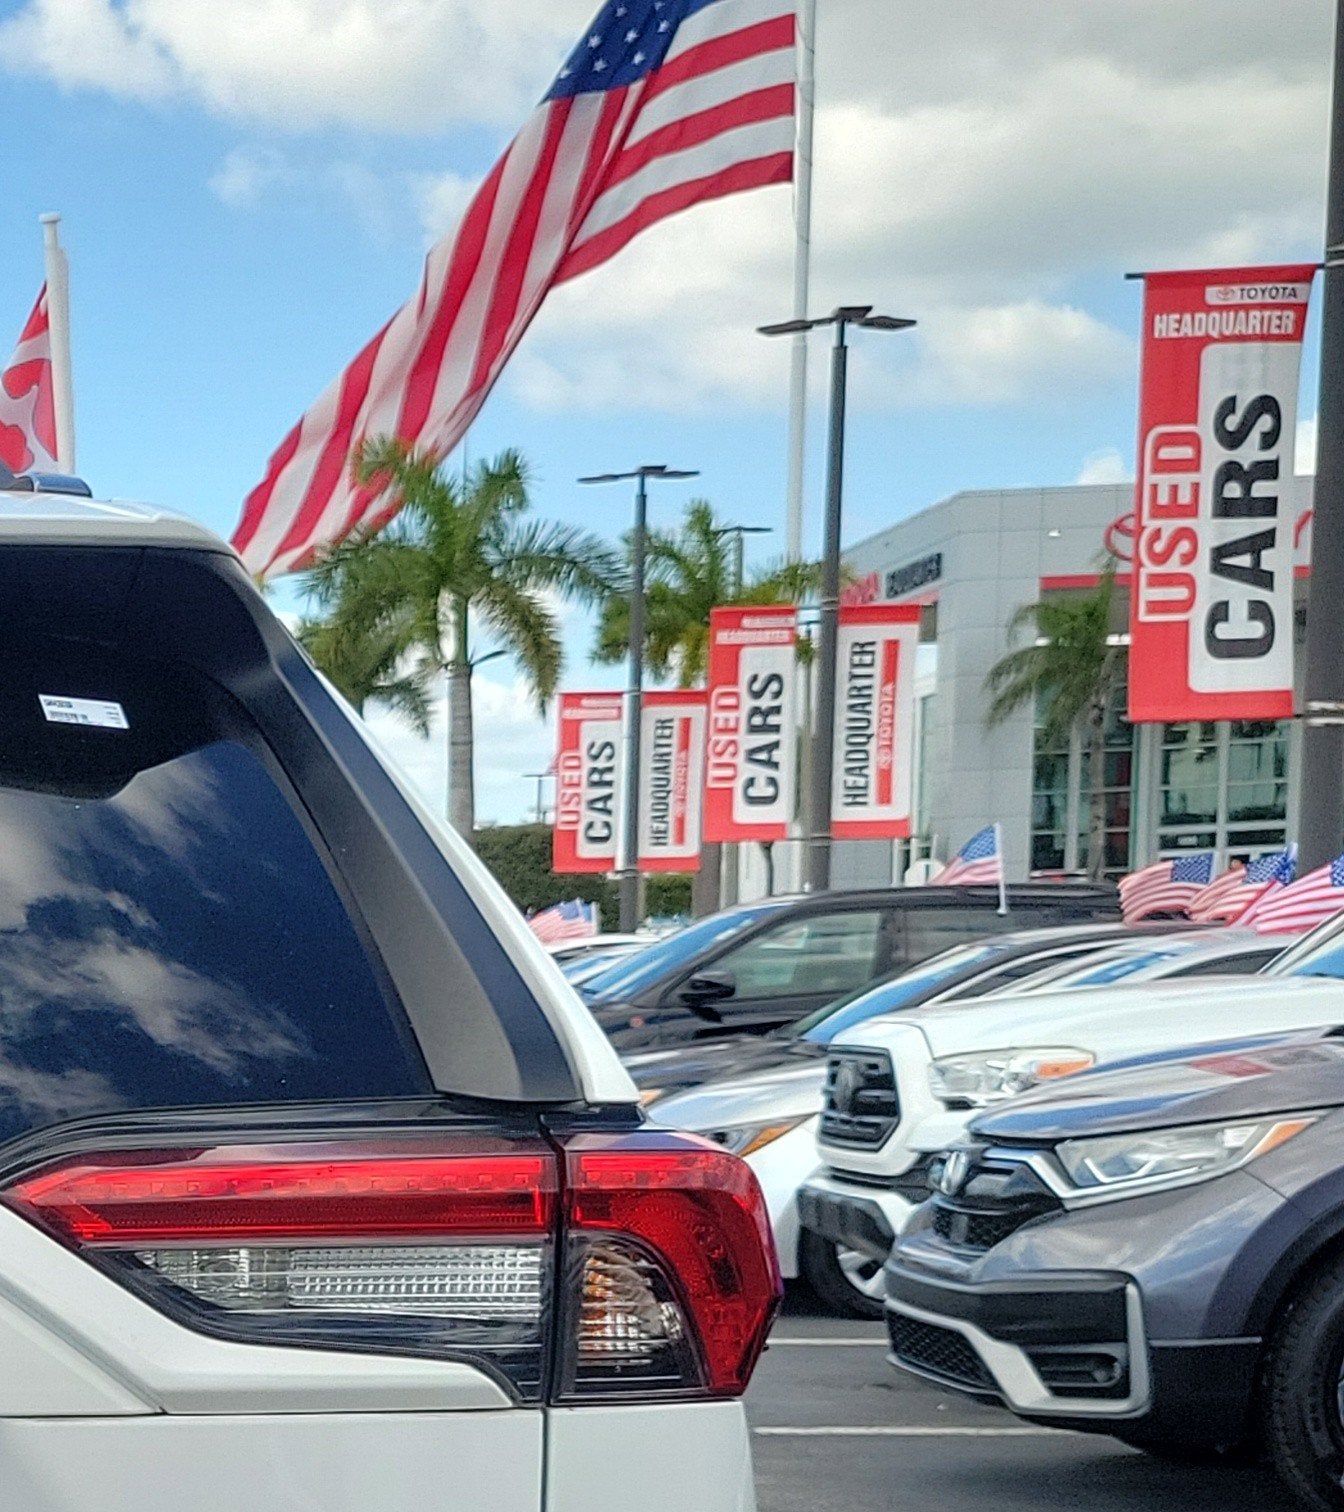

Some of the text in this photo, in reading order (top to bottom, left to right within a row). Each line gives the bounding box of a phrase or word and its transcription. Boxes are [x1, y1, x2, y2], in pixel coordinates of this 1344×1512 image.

[1153, 310, 1295, 338] HEADQUARTER
[1239, 286, 1298, 300] TOYOTA
[1146, 431, 1201, 616] USED
[1205, 394, 1282, 660] CARS
[649, 717, 674, 847] HEADQUARTER
[712, 690, 741, 783] USED
[743, 672, 784, 807] CARS
[842, 640, 877, 807] HEADQUARTER
[560, 754, 582, 825] USED
[585, 740, 616, 844] CARS
